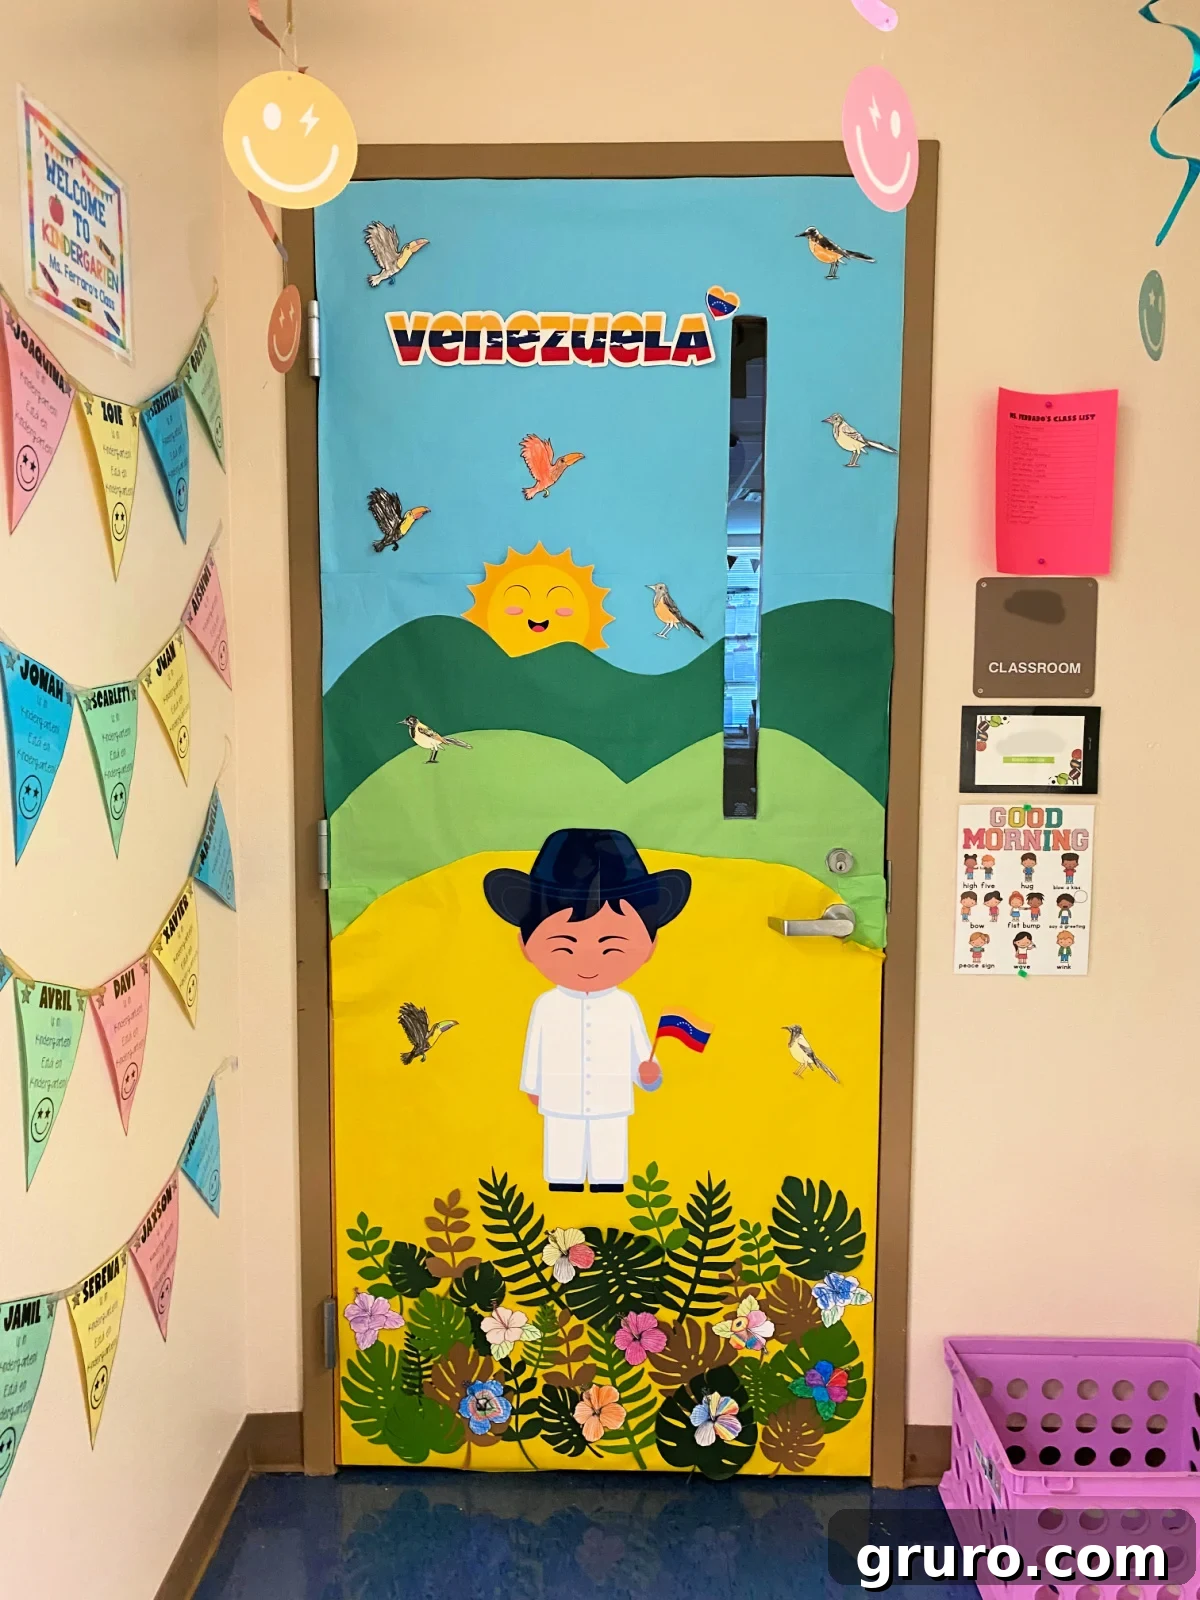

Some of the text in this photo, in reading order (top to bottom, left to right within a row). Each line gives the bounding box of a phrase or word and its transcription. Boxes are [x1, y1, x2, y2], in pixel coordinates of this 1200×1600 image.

[44, 152, 107, 229] WELCOME
[72, 209, 91, 244] TO
[41, 217, 120, 294] KINDERGARTEN
[49, 253, 116, 311] Ms. Ferraro's Class
[13, 322, 65, 395] JOAQUINA
[100, 400, 124, 426] ZOIE
[1053, 414, 1077, 422] CLASS
[156, 641, 176, 676] JUAN
[988, 662, 1081, 674] CLASSROOM
[20, 658, 64, 702] JONAH
[92, 686, 130, 709] SCARLETT
[990, 806, 1063, 828] GOOD
[962, 828, 1090, 852] MORNING
[962, 882, 978, 890] high
[162, 894, 189, 944] XAVIER
[39, 985, 72, 1011] AVRIL
[113, 968, 136, 1000] DAVI
[140, 1186, 172, 1244] JAXSON
[83, 1256, 120, 1303] SERENA
[4, 1299, 41, 1332] JAMIL
